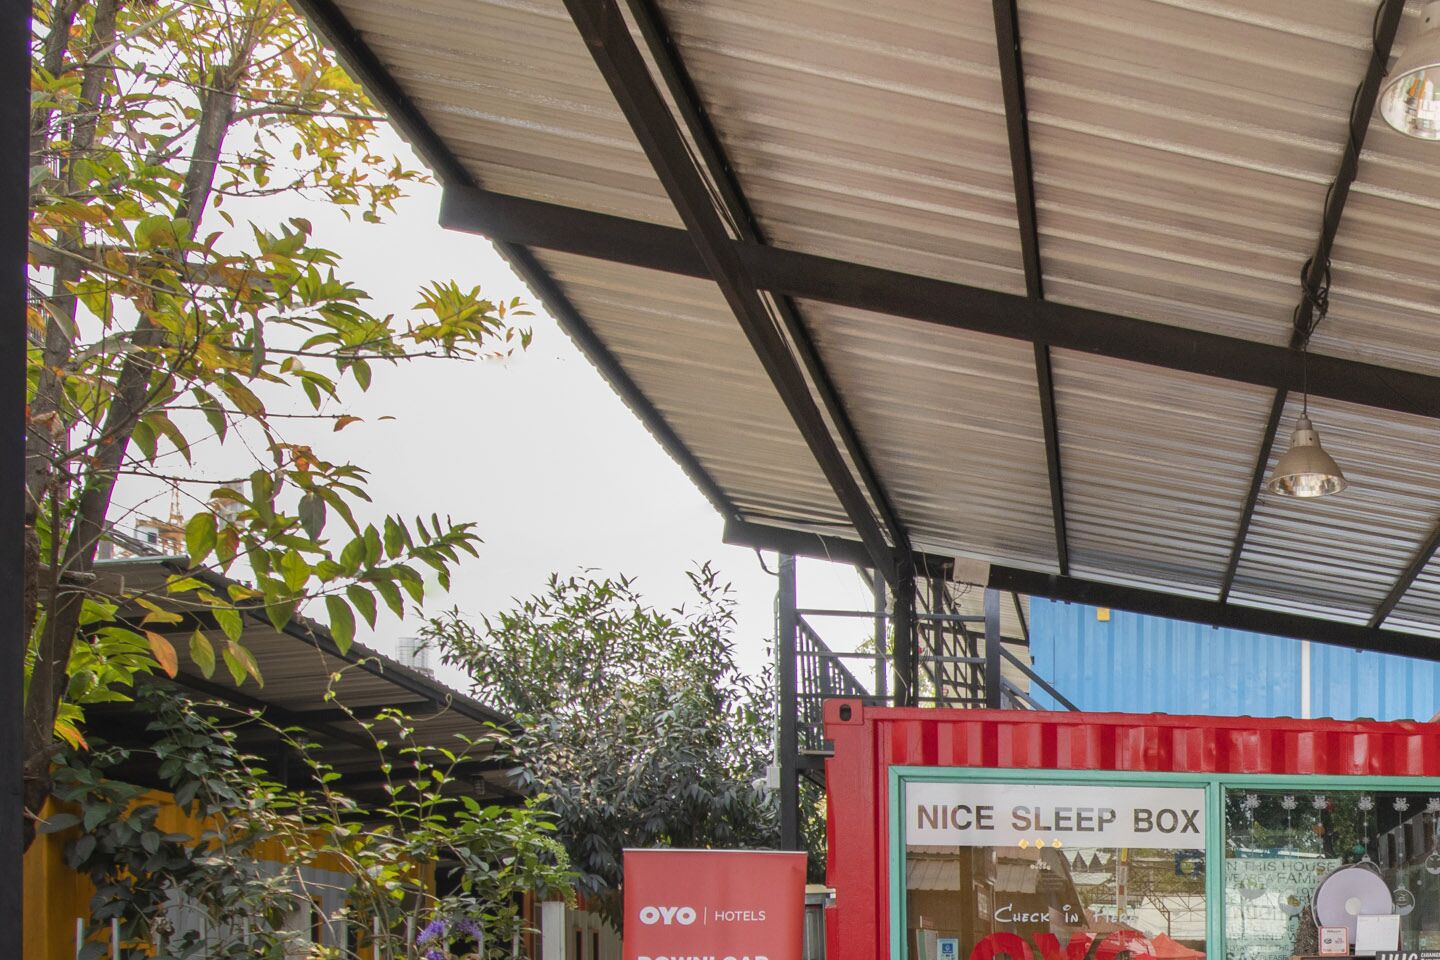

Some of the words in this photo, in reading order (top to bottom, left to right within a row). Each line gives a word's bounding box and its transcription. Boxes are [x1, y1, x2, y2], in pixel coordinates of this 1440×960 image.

[917, 804, 995, 831] NICE
[1011, 805, 1117, 832] SLEEP
[1133, 808, 1201, 834] BOX
[639, 906, 697, 925] OYO
[714, 910, 766, 921] HOTELS
